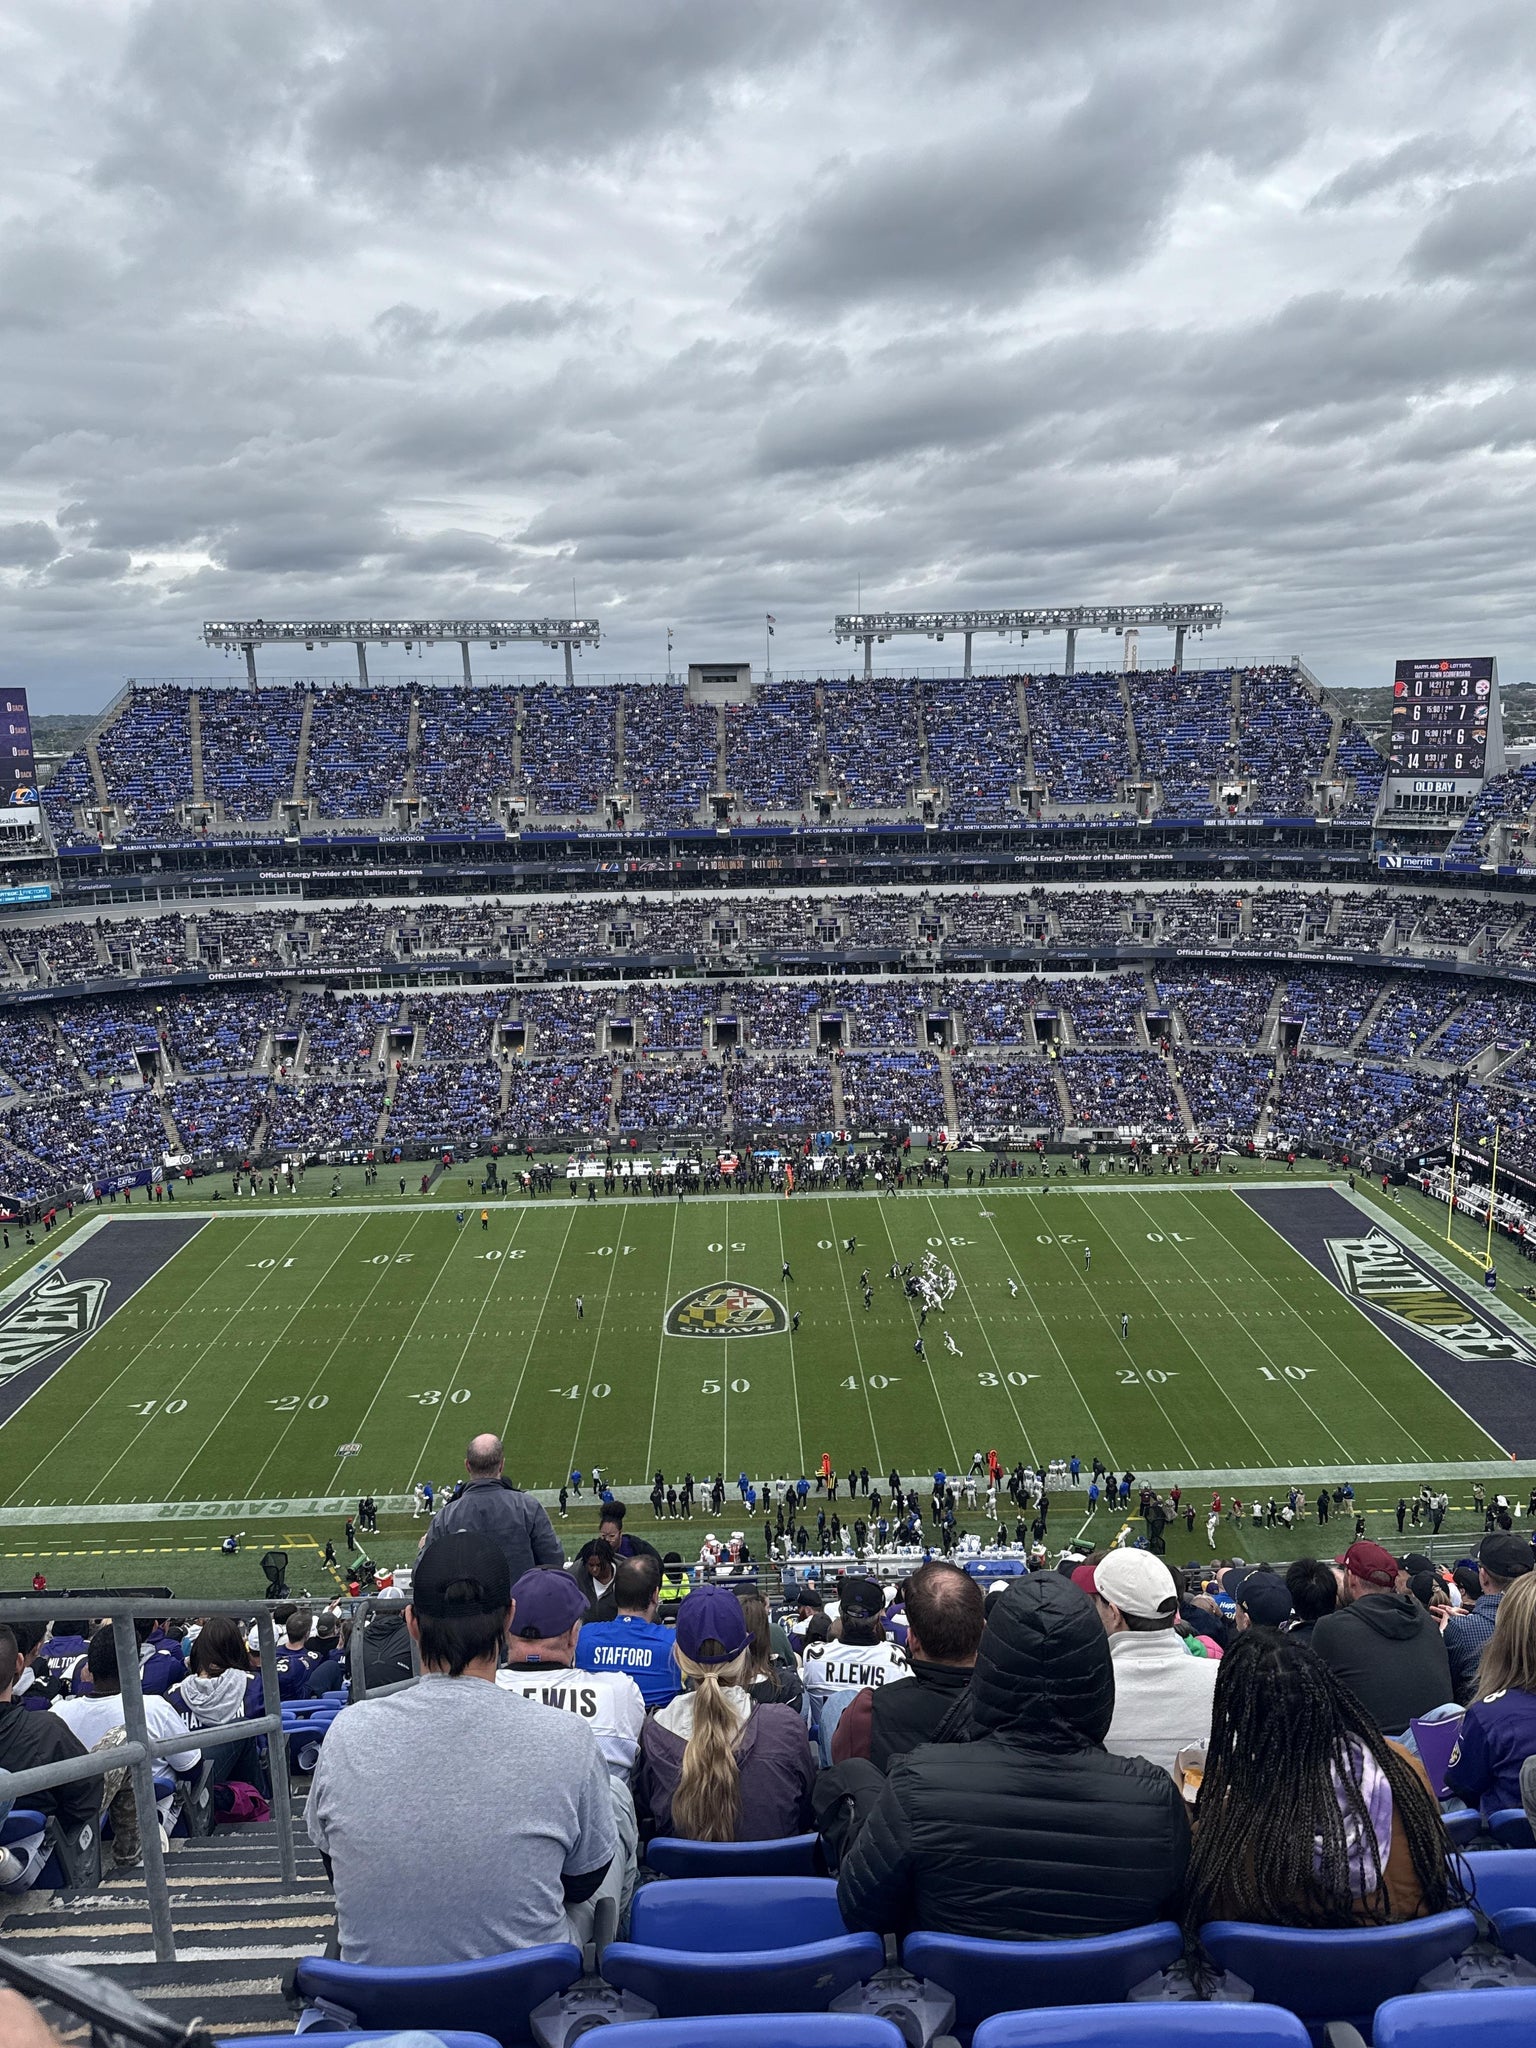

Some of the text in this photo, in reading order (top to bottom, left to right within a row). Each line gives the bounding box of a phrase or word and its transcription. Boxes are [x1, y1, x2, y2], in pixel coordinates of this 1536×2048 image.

[1415, 681, 1422, 696] 0
[1461, 680, 1468, 696] 3
[1414, 705, 1420, 720] 6
[1460, 705, 1466, 720] 7
[1412, 729, 1418, 744] 0
[1457, 729, 1464, 744] 6
[1408, 753, 1462, 769] 14 6
[1416, 782, 1454, 792] OLD BAY
[624, 863, 628, 871] 0
[751, 860, 766, 868] 14:11
[1326, 954, 1353, 962] Ravens
[238, 971, 264, 979] Energy
[19, 993, 54, 1001] Constellation
[117, 1177, 136, 1186] CATCH
[1421, 1186, 1476, 1218] ALTIORE
[926, 1237, 967, 1247] 30
[1036, 1234, 1077, 1246] 20
[1146, 1232, 1186, 1244] 10
[484, 1250, 526, 1260] 30
[597, 1246, 636, 1256] 40
[707, 1242, 746, 1253] 50
[257, 1258, 297, 1269] 10
[373, 1253, 415, 1265] 20
[1326, 1237, 1520, 1361] BALTIMORE
[1426, 1256, 1474, 1286] TAKES
[1469, 1291, 1503, 1308] ALL
[1499, 1314, 1530, 1329] OF
[0, 1280, 104, 1377] AVENS
[977, 1371, 1029, 1387] 30
[1114, 1369, 1169, 1384] 20
[1256, 1365, 1308, 1381] 10
[701, 1379, 751, 1394] 50
[840, 1375, 888, 1390] 40
[418, 1388, 471, 1405] 30
[561, 1384, 612, 1399] 40
[135, 1399, 188, 1415] 10
[274, 1395, 329, 1411] 20
[158, 1501, 289, 1517] CANCER
[594, 1646, 652, 1667] STAFFORD
[826, 1662, 885, 1686] R.LEWIS
[508, 1688, 597, 1717] EWIS
